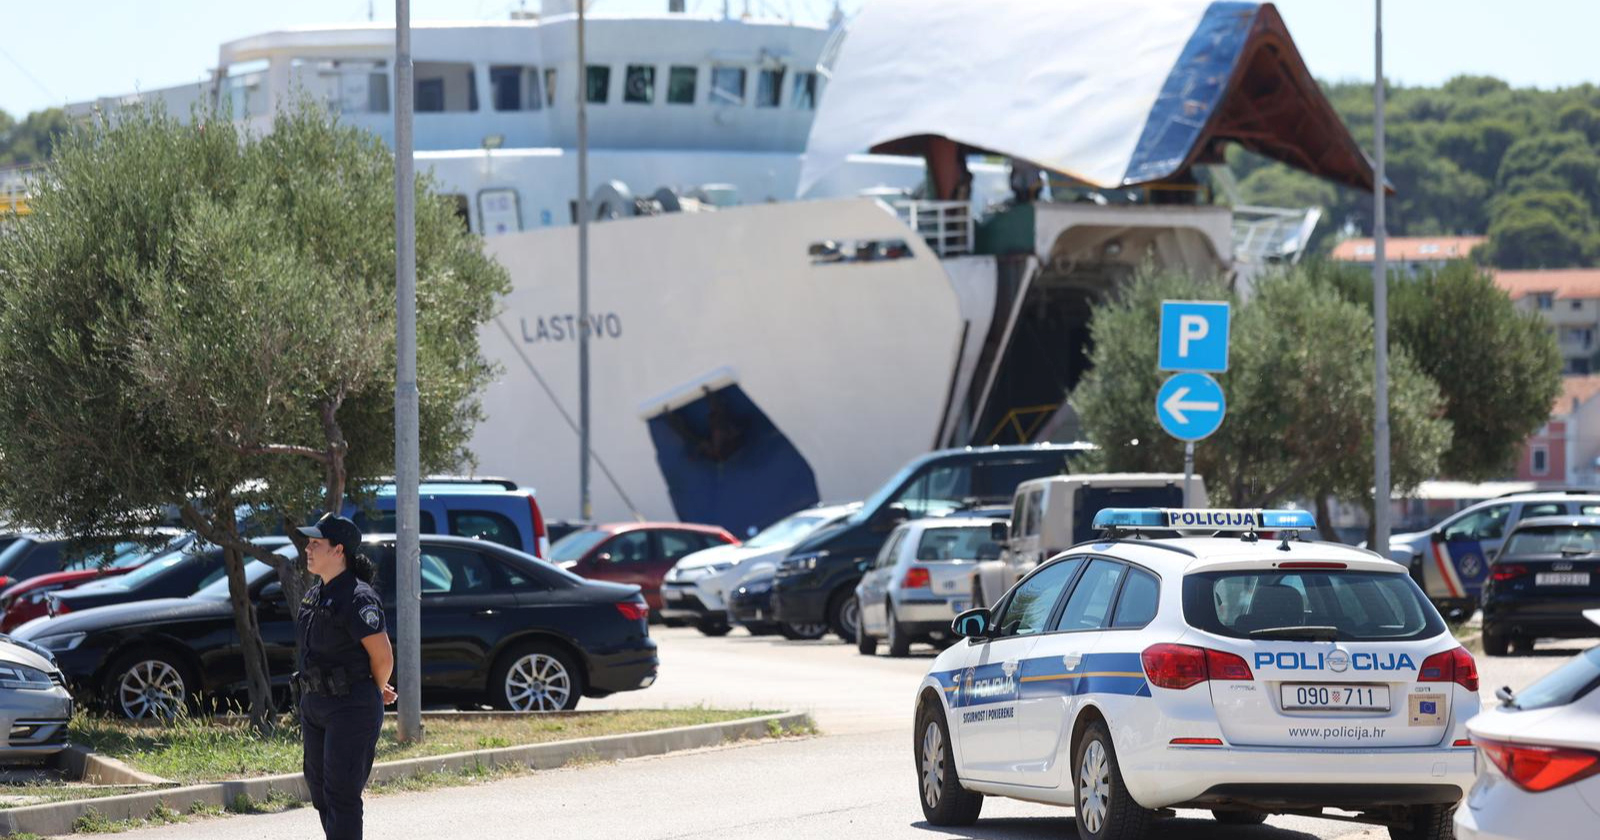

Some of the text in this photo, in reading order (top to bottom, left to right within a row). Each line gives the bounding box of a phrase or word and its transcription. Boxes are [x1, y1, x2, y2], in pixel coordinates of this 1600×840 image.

[1179, 314, 1210, 358] P
[1170, 512, 1256, 526] POLICIJA
[974, 677, 1015, 698] POLICIJA
[1297, 687, 1374, 706] 090 711
[1288, 726, 1386, 741] www.policija.hr
